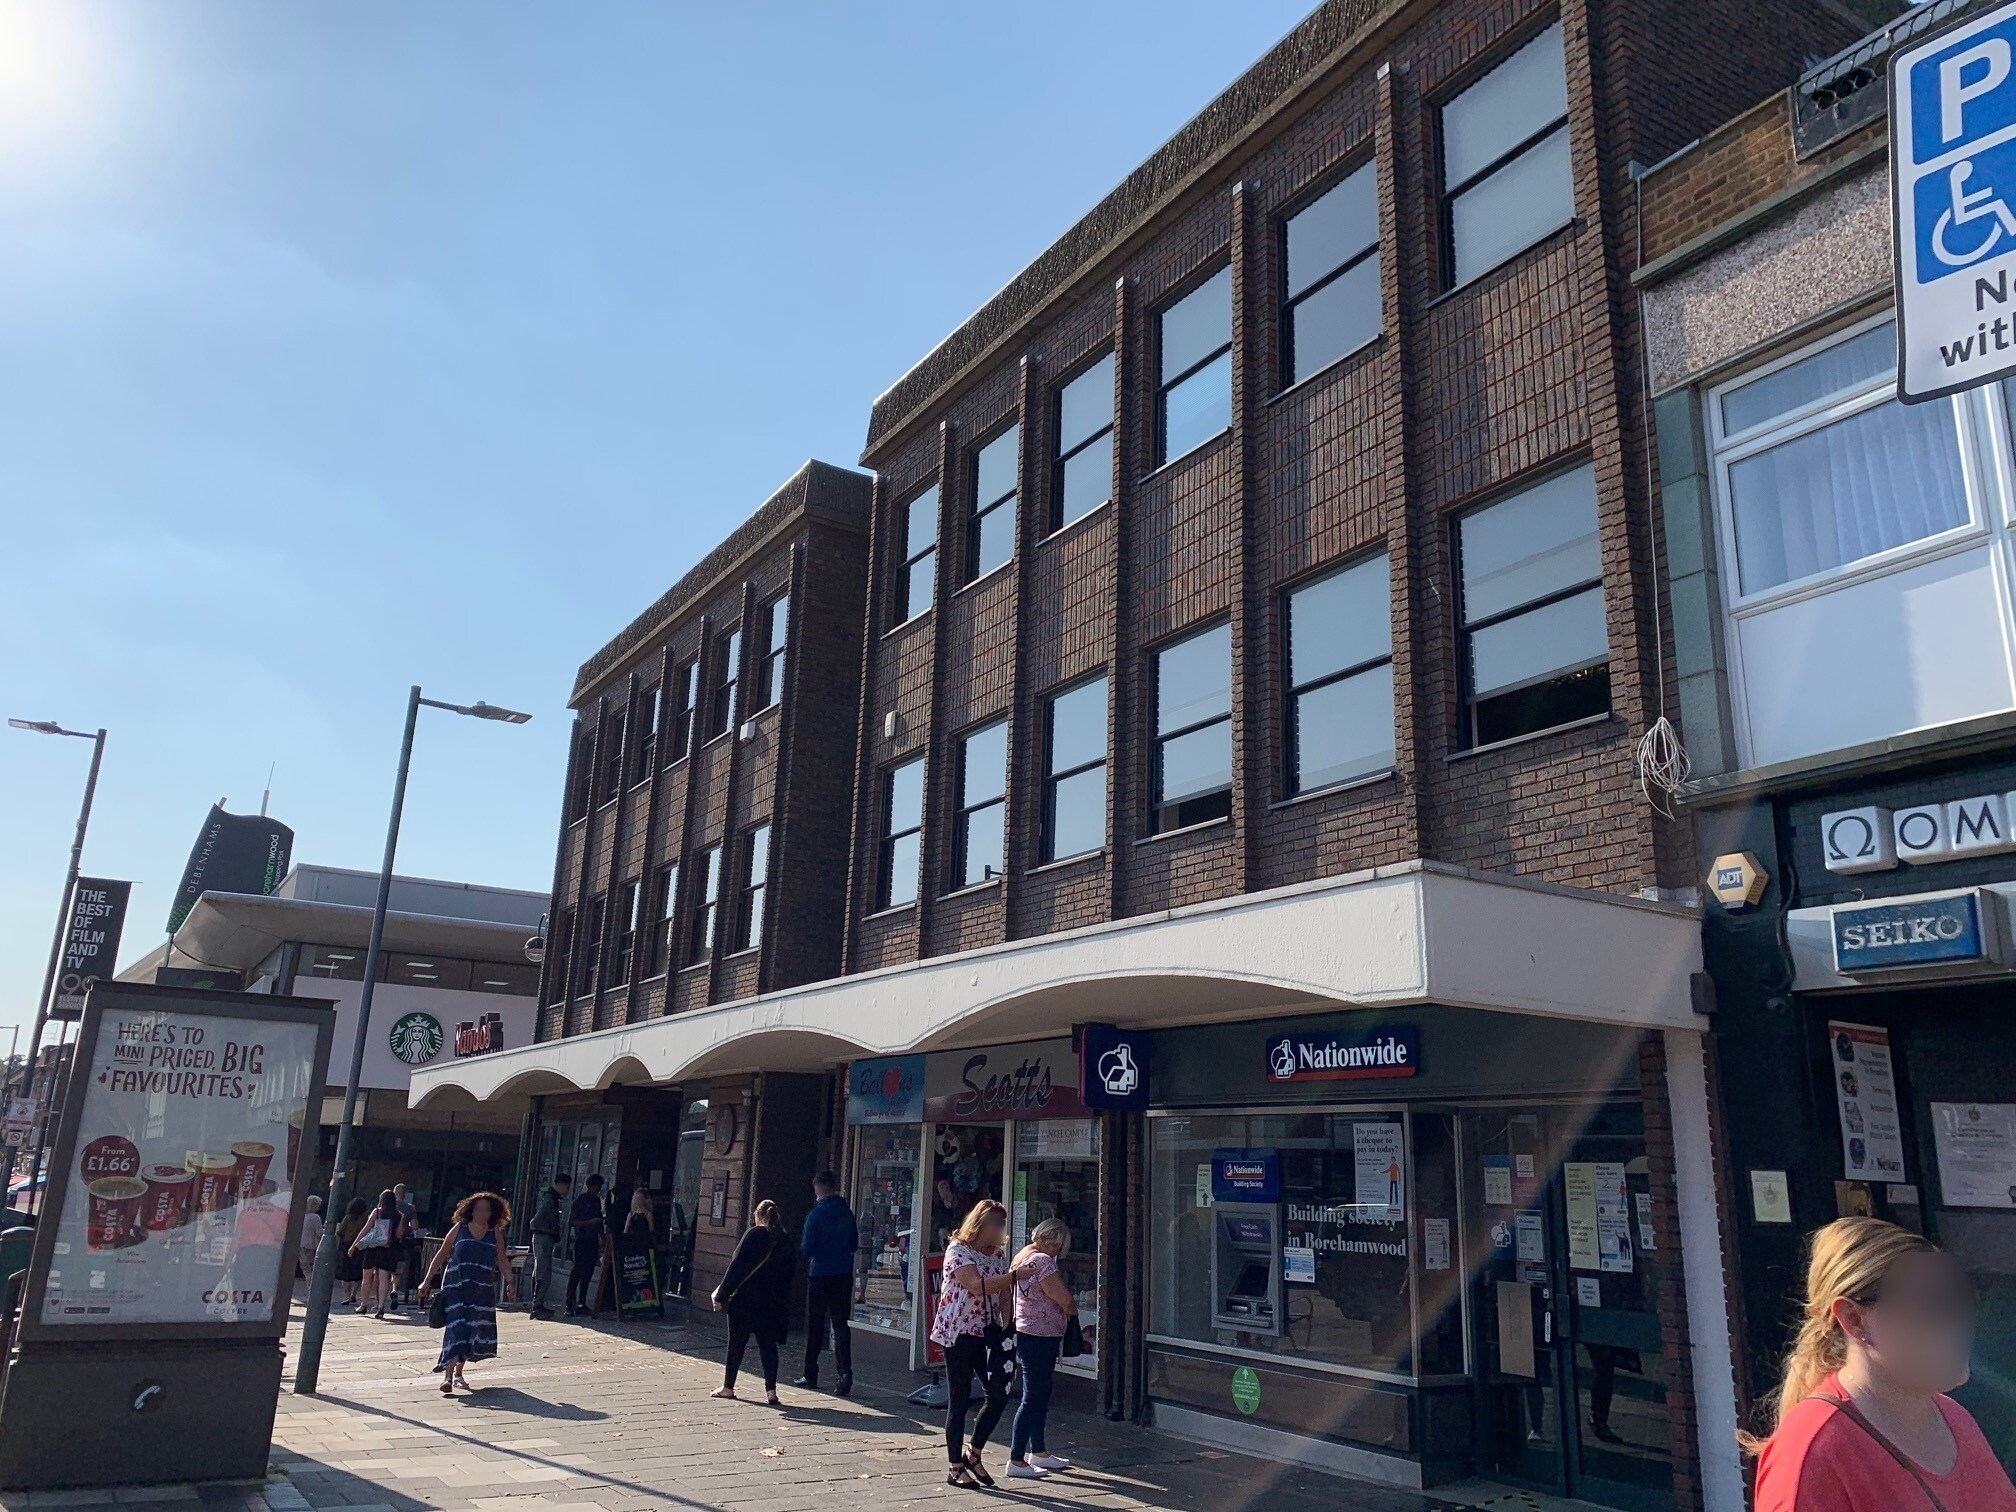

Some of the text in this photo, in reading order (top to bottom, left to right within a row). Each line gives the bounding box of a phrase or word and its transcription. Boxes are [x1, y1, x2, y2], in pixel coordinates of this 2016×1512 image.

[1939, 38, 2012, 144] P
[1975, 269, 2016, 312] N
[1939, 311, 2016, 367] wit
[187, 822, 222, 894] DEBENHAMS
[262, 834, 280, 896] orehamwood
[1718, 868, 1744, 890] ADT
[80, 889, 107, 904] THE
[76, 903, 114, 918] BEST
[74, 916, 94, 929] OF
[1842, 914, 1964, 952] SEIKO
[70, 930, 105, 944] FILM
[67, 944, 99, 957] AND
[66, 956, 85, 969] TV
[118, 1022, 205, 1046] HERE'S TO
[114, 1042, 265, 1075] MINI PRICED, BIG
[1298, 1037, 1407, 1069] Nationwide
[110, 1069, 244, 1099] FAVOURITES
[954, 1054, 1055, 1117] Scotts
[1356, 1128, 1394, 1138] Do you have
[1361, 1136, 1384, 1146] cheque
[101, 1145, 126, 1156] From
[1356, 1146, 1368, 1155] pay
[1377, 1146, 1399, 1155] today?
[1234, 1165, 1264, 1176] Nationwide
[1234, 1180, 1264, 1189] Building Society
[154, 1191, 171, 1223] COSTA
[1287, 1204, 1345, 1228] Building
[1287, 1230, 1407, 1258] in Borehamwood
[201, 1290, 264, 1304] COSTA
